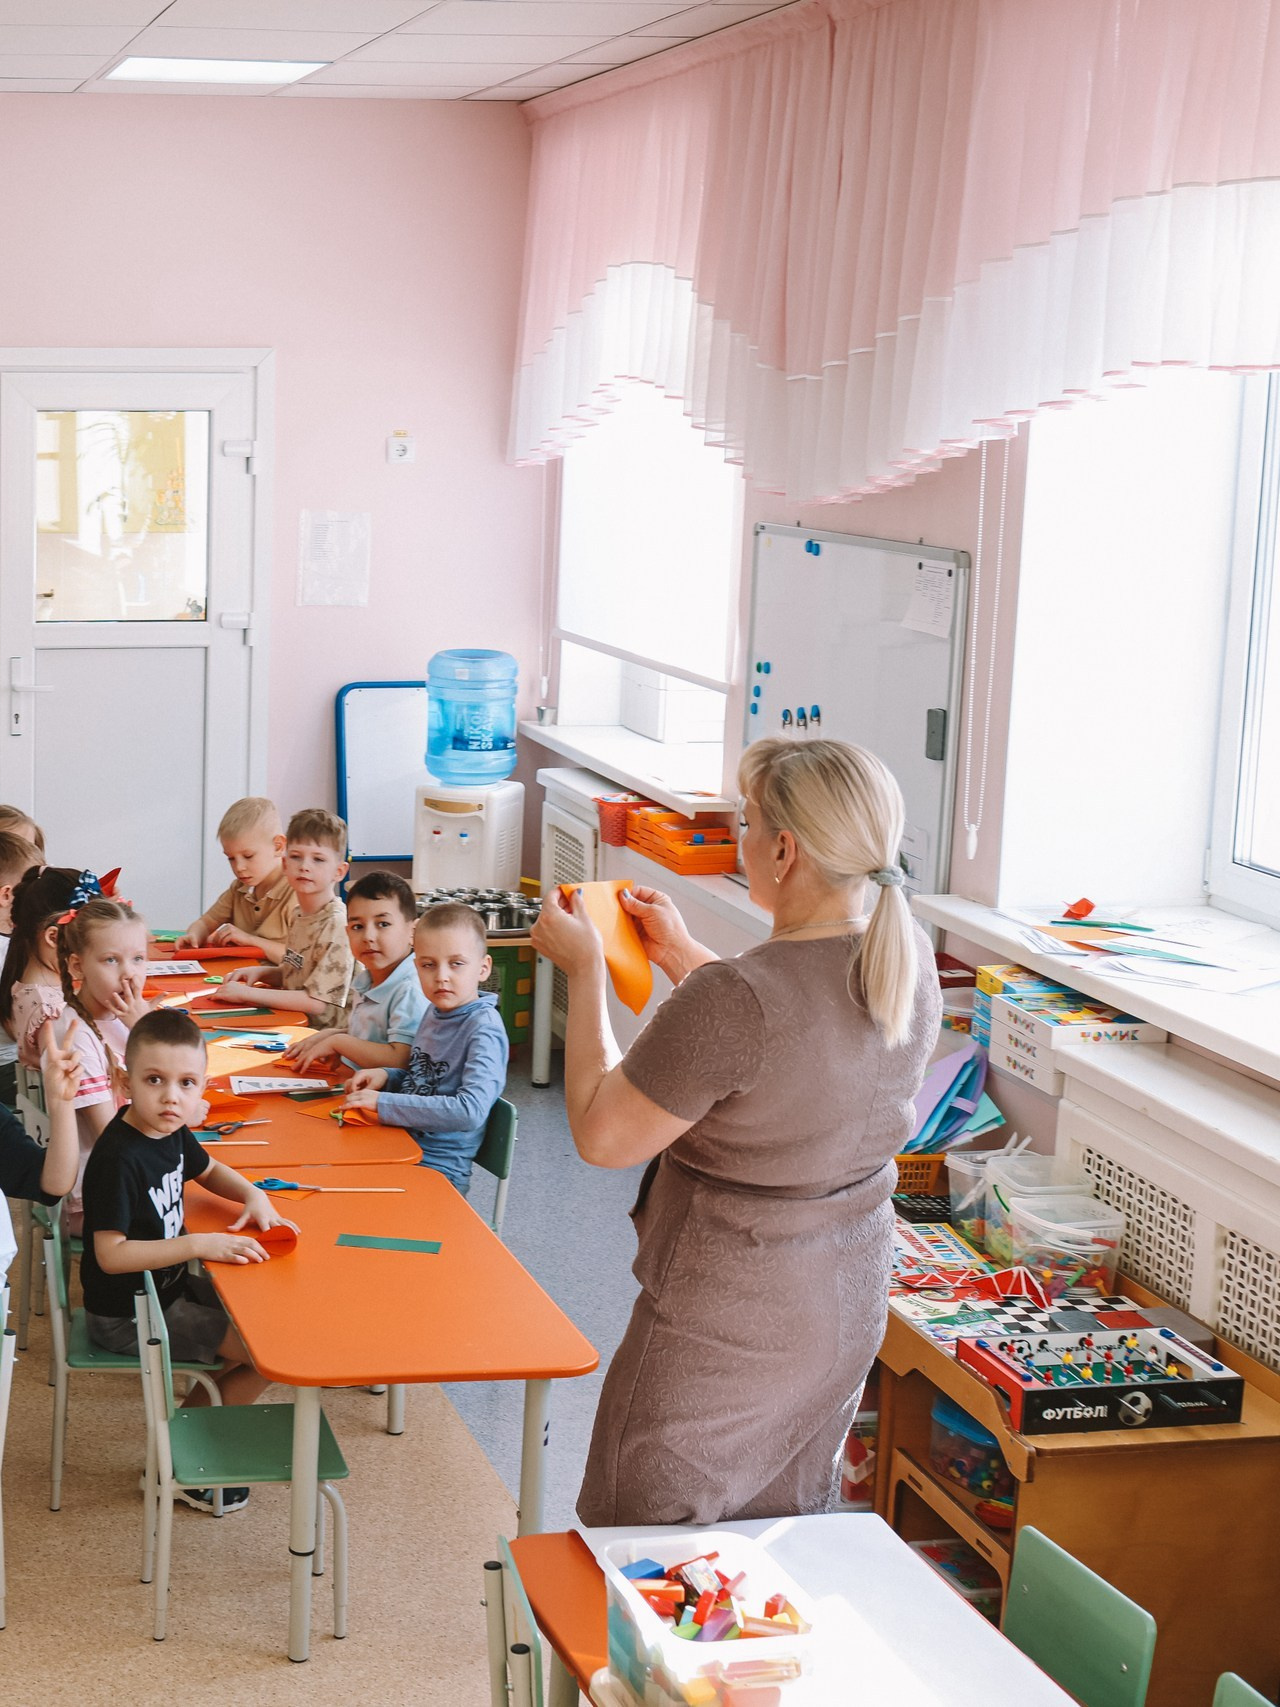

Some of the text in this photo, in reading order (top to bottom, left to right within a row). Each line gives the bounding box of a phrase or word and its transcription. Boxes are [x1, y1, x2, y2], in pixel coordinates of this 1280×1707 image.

[1080, 1029, 1140, 1043] ТОМИК
[911, 1225, 962, 1261] ПЛАКАТЫ
[1042, 1405, 1105, 1421] ФУТБОЛ
